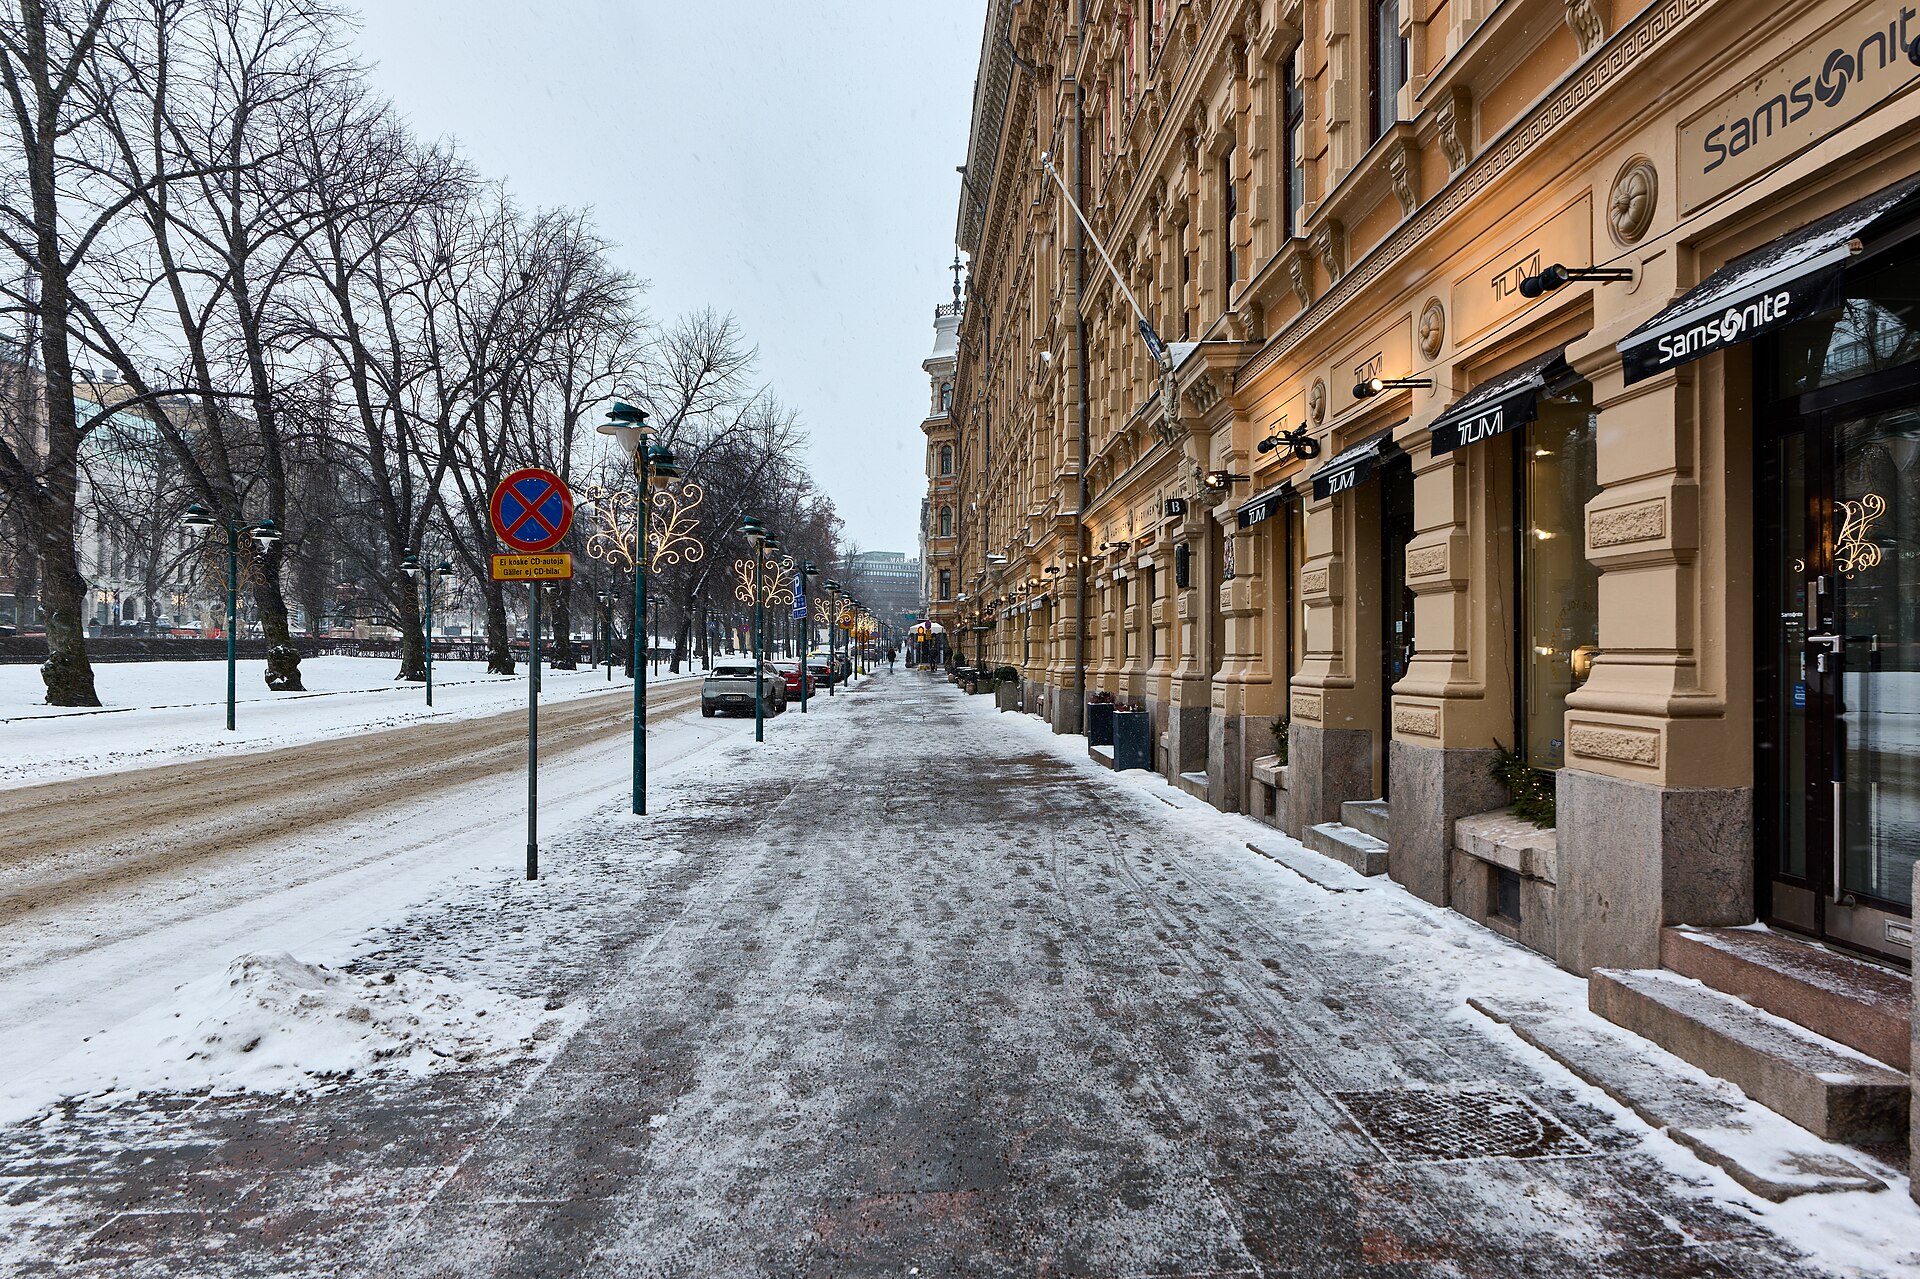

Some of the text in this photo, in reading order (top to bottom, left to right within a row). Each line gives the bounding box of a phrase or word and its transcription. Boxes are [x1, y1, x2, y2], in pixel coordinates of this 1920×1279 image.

[1704, 6, 1917, 174] Samsonit
[1491, 248, 1540, 302] TUMI
[1658, 291, 1790, 364] Samsonite
[1354, 351, 1383, 385] TUMI
[1458, 405, 1503, 446] TUMI
[1328, 466, 1355, 495] TUMI
[1248, 503, 1266, 525] TUMI
[499, 558, 507, 566] Ei
[508, 558, 529, 566] koske
[503, 568, 523, 576] Gäller
[524, 568, 532, 577] ej
